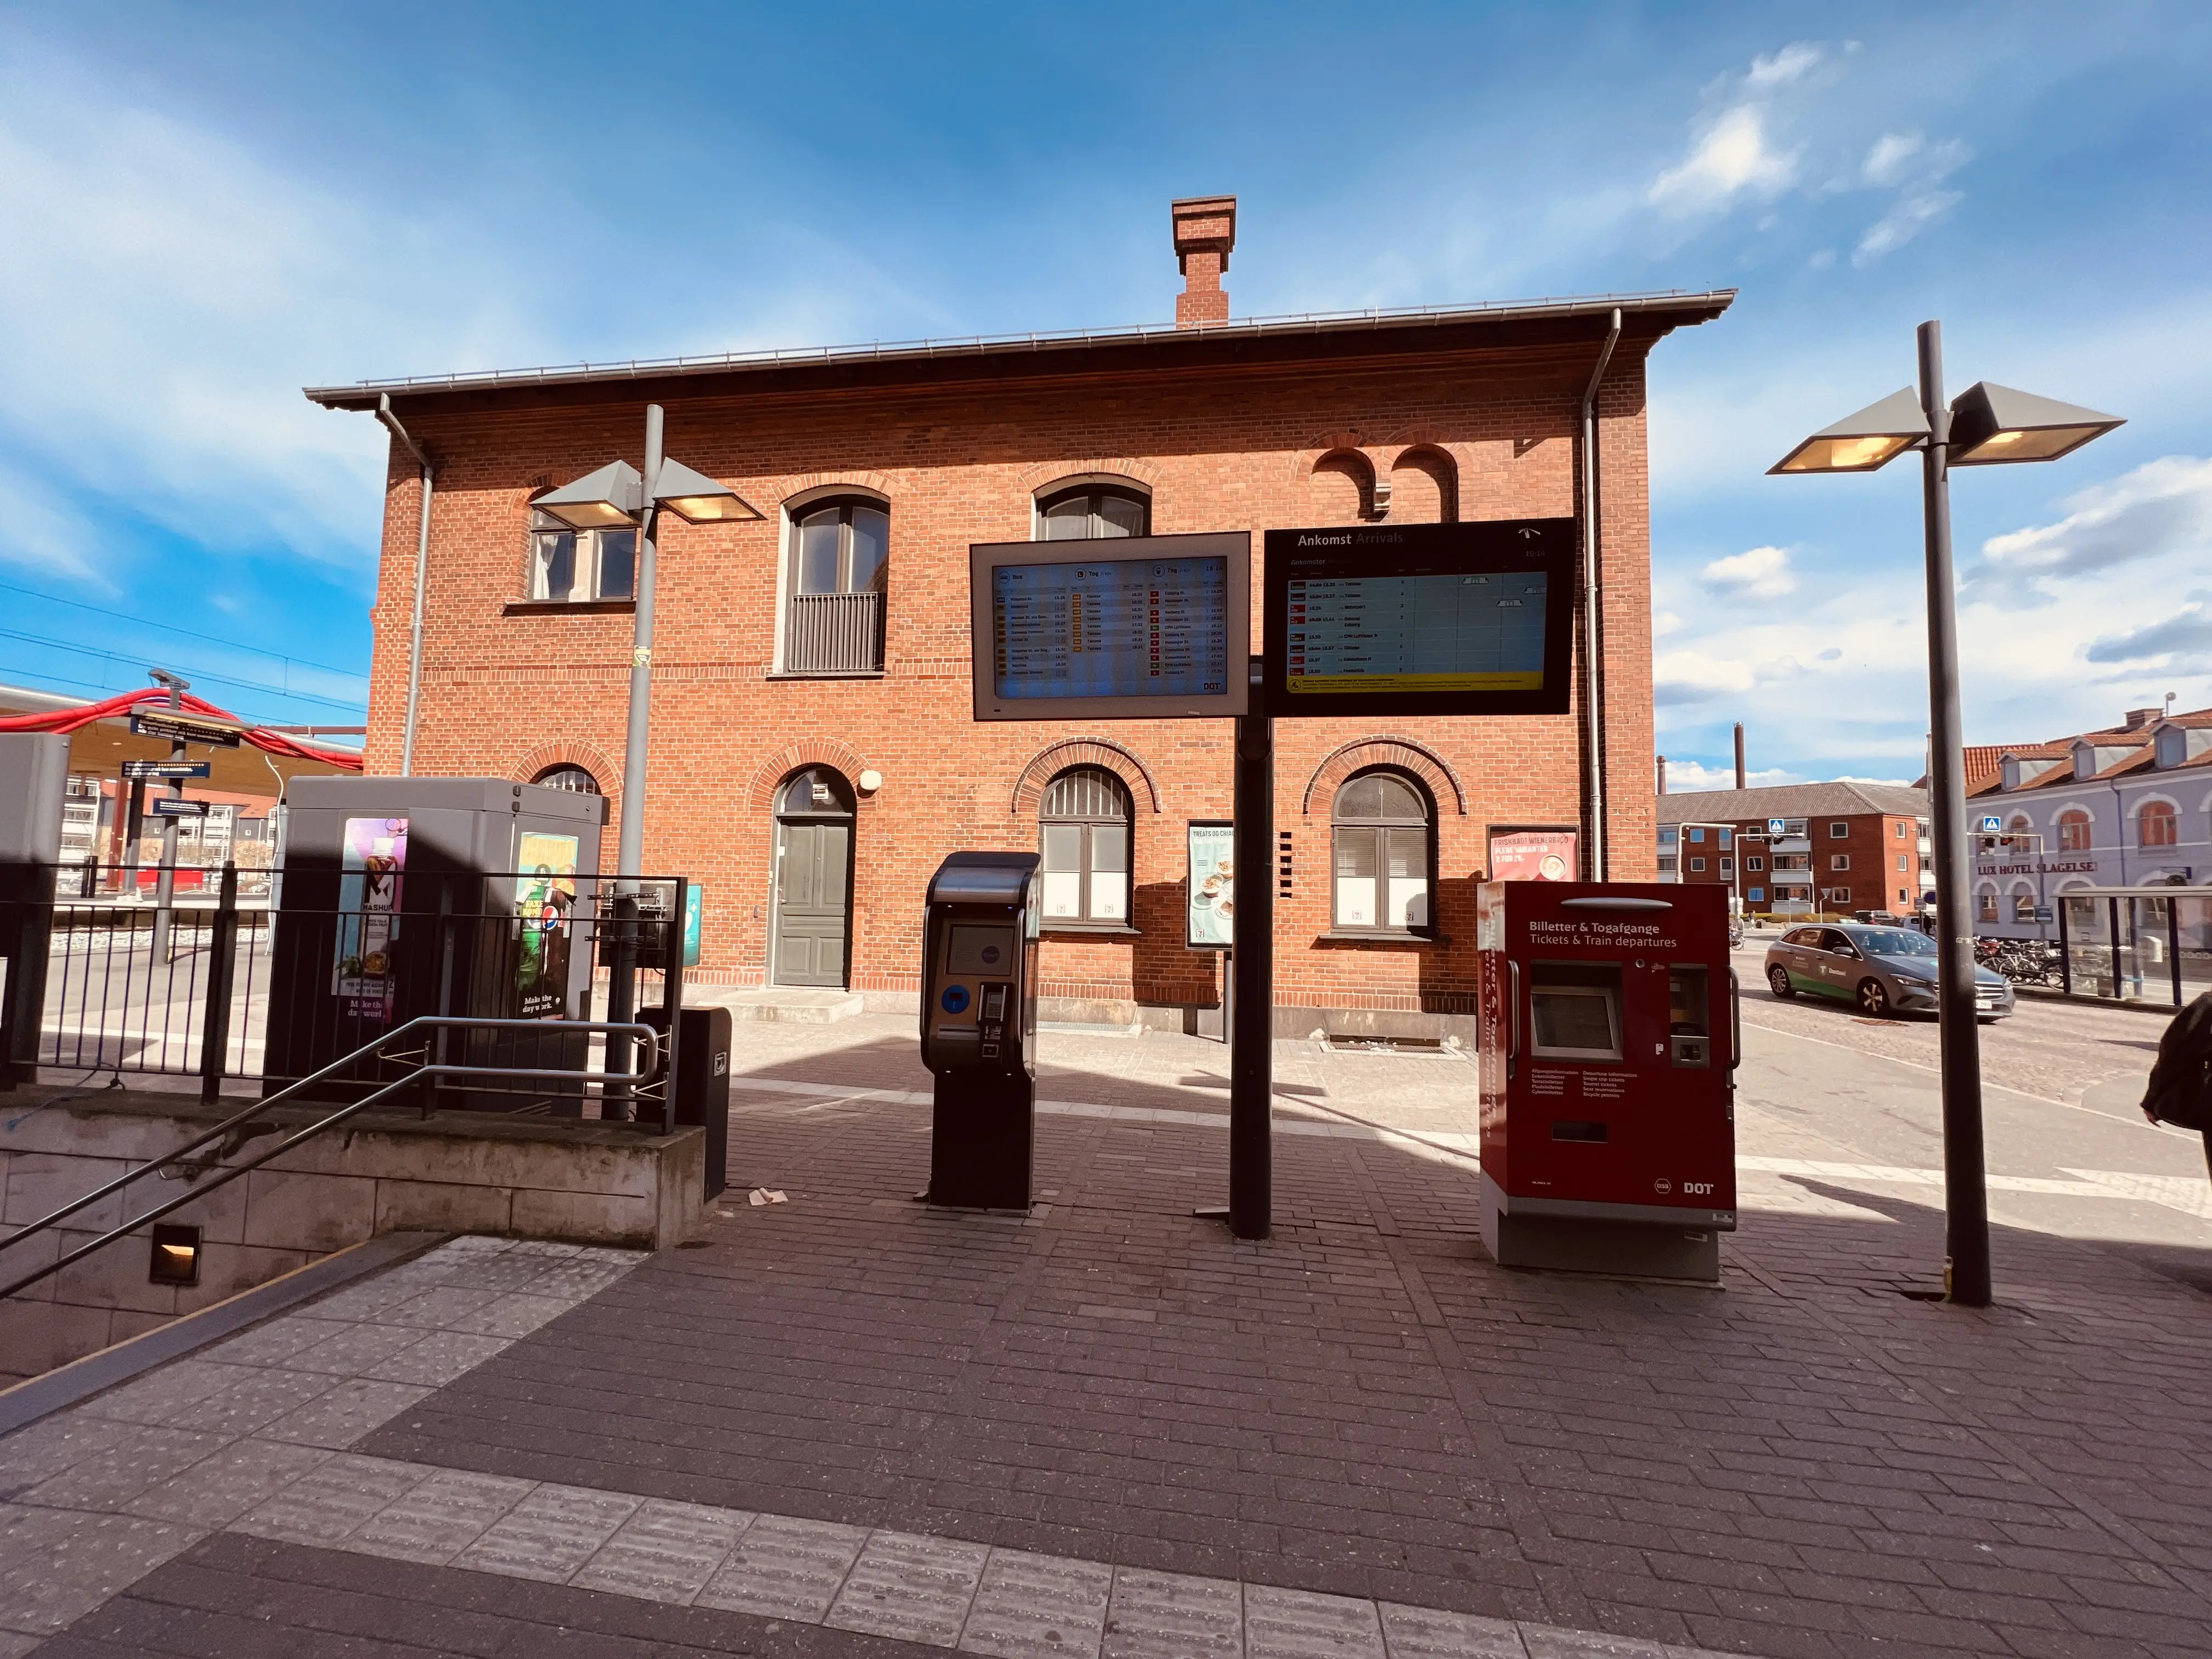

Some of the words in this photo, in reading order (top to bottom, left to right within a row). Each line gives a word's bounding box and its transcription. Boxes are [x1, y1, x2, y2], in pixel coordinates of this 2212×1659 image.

[1297, 534, 1352, 546] Ankomst
[1356, 532, 1403, 544] Arrivals
[1494, 837, 1527, 846] FRISKBAGT
[1528, 836, 1568, 844] WIENERBRØD
[1978, 866, 1996, 875] LUX
[1999, 864, 2034, 874] HOTEL
[1529, 921, 1576, 932] Billetter
[1579, 923, 1588, 932] &
[1591, 922, 1660, 935] Togafgange
[1530, 934, 1569, 944] Tickets
[1572, 935, 1581, 944] &
[1584, 935, 1611, 945] Train
[1615, 936, 1677, 948] departures
[522, 1005, 535, 1014] day
[1684, 1182, 1714, 1194] DOT
